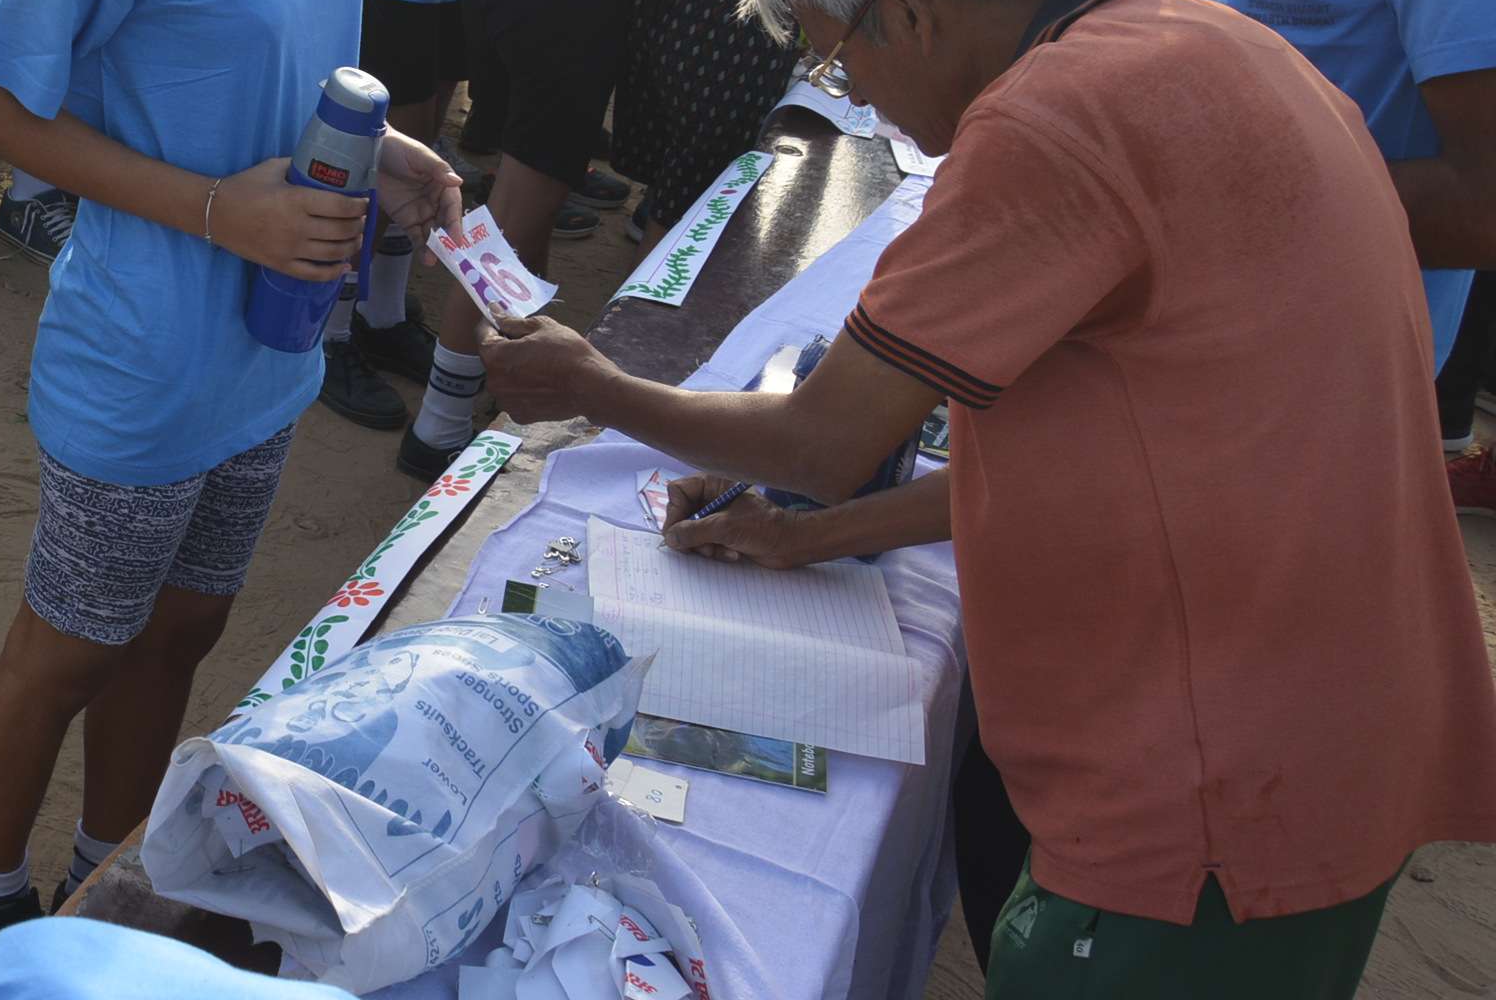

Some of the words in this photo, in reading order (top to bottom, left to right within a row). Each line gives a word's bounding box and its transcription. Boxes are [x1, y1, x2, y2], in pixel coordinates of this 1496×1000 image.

[455, 671, 525, 734] Stronger
[488, 670, 540, 719] Sports
[414, 699, 487, 780] Tracksuits
[421, 757, 469, 806] Lower
